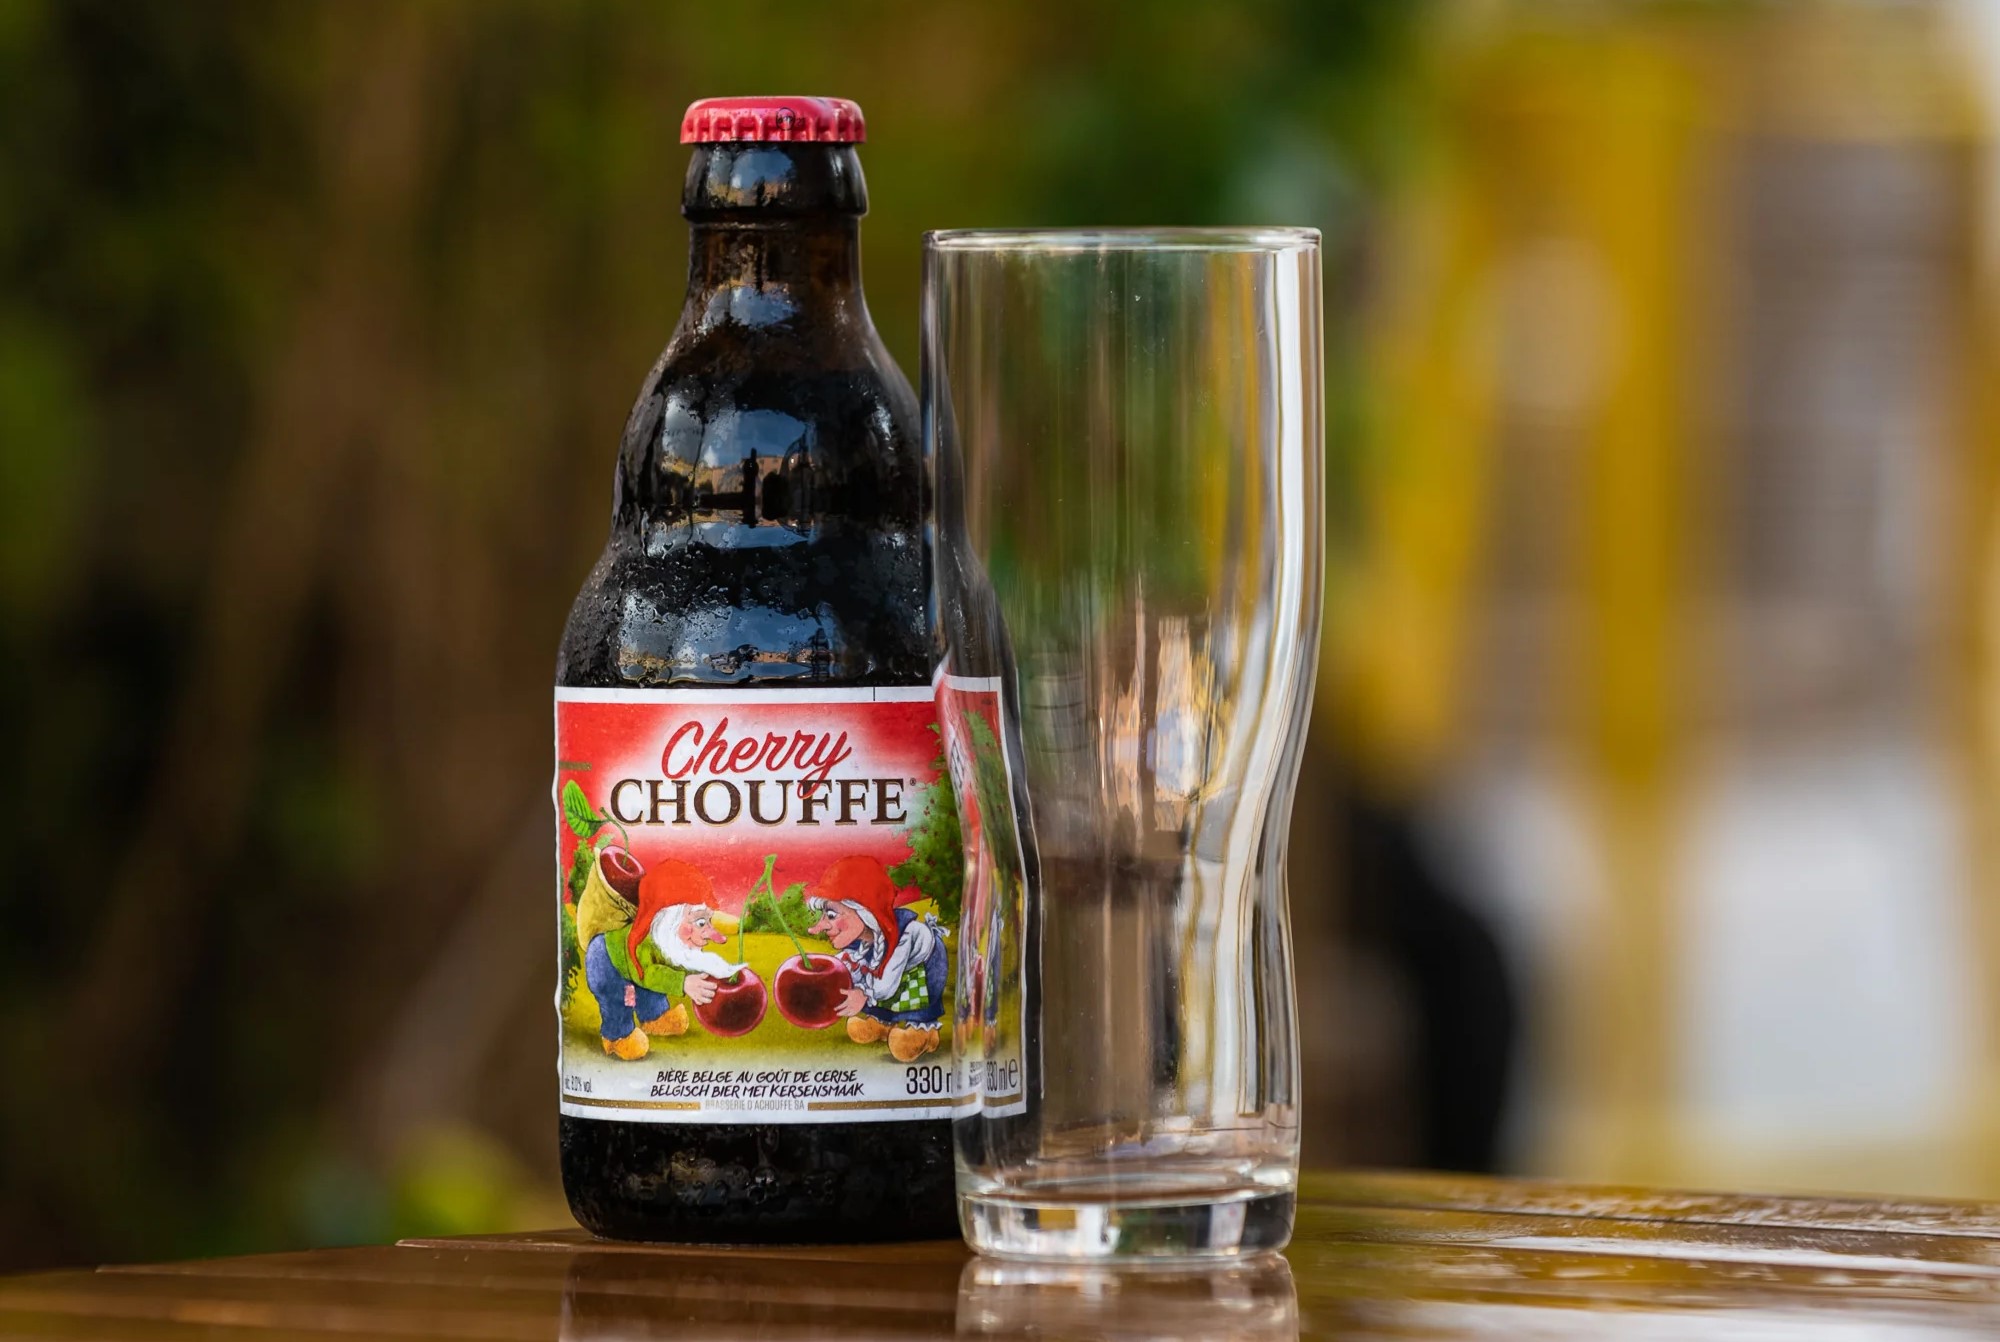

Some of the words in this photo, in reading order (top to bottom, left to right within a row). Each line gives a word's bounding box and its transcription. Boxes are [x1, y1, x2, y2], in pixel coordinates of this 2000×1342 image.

[661, 716, 852, 799] Cherry
[610, 777, 908, 827] CHOUFFE
[650, 1084, 710, 1098] BELGISCH
[711, 1084, 740, 1099] BIER
[742, 1084, 769, 1098] MET
[769, 1082, 865, 1099] KERSENSMAAK
[656, 1067, 690, 1083] BIÈRE
[691, 1070, 734, 1083] BELGE
[735, 1070, 754, 1083] AU
[793, 1070, 811, 1083] DE
[814, 1069, 858, 1084] CERISE
[906, 1065, 942, 1095] 330
